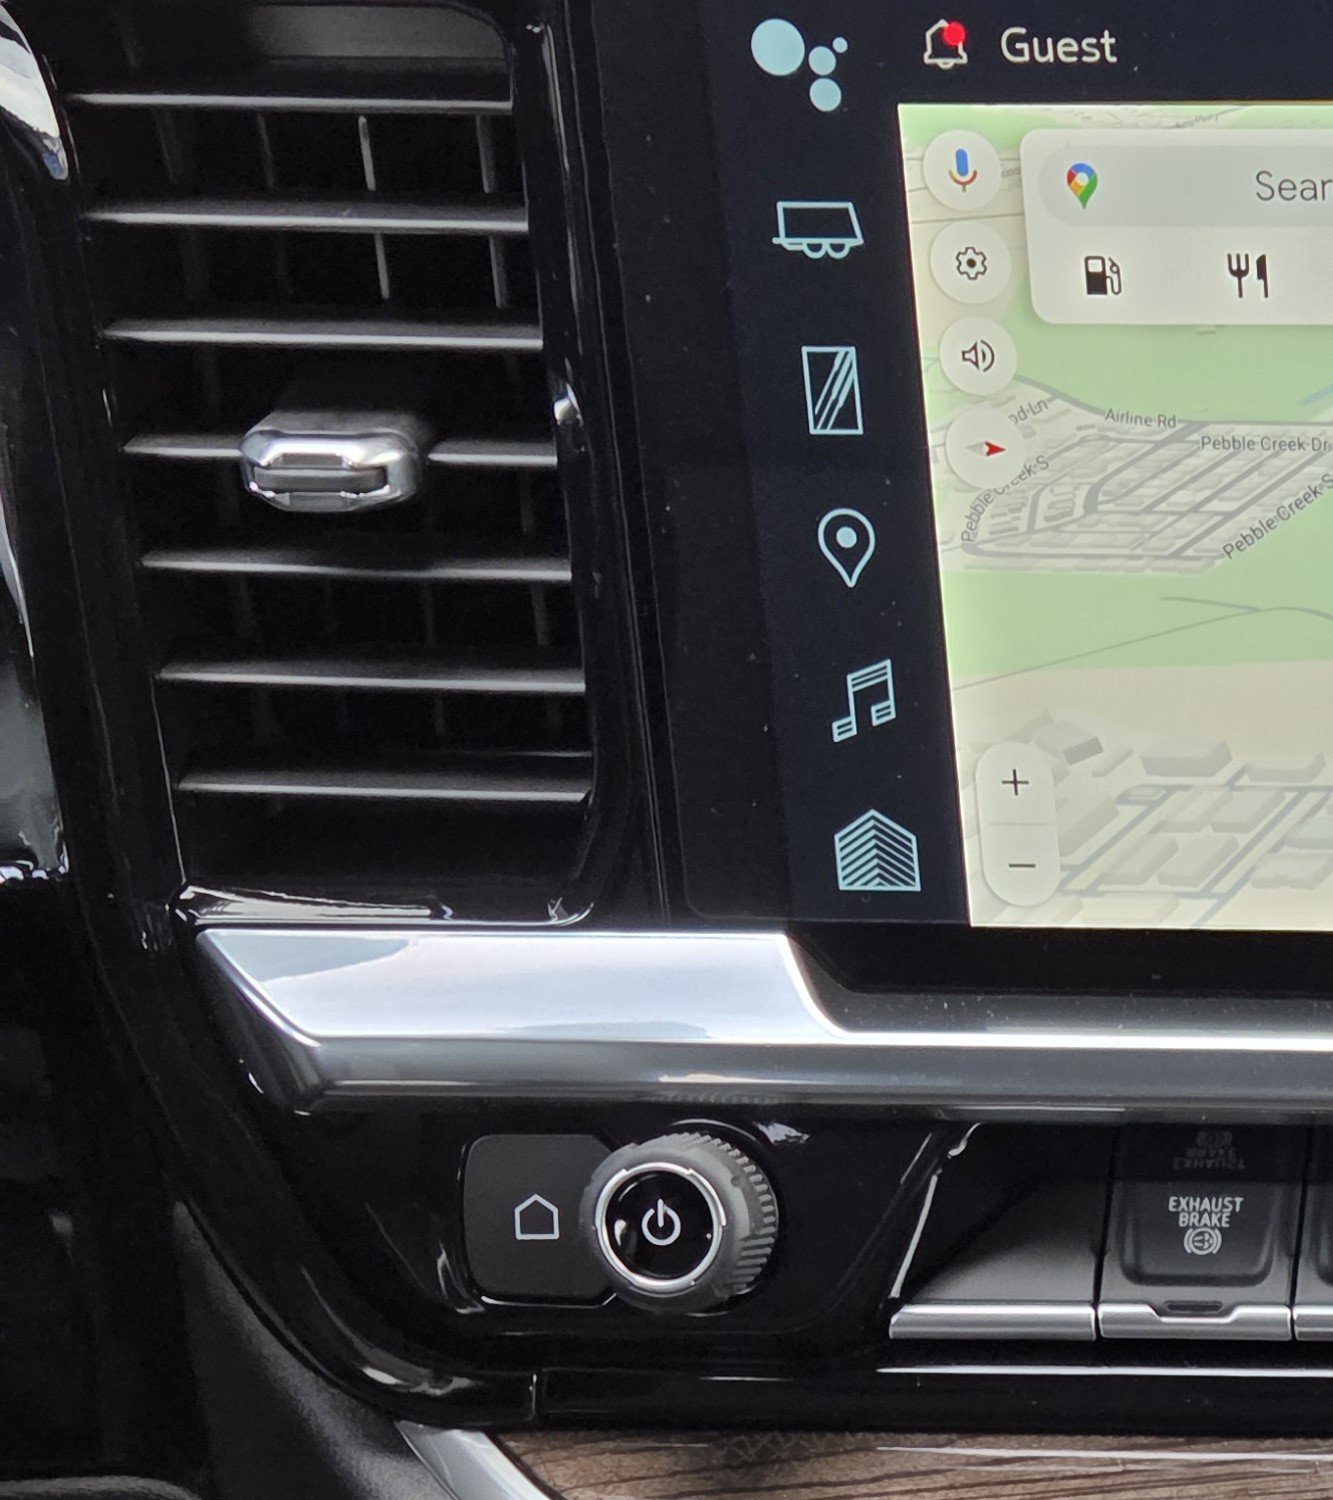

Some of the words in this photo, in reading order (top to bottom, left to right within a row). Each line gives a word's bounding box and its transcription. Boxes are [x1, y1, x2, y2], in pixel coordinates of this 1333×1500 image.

[1001, 27, 1118, 64] Guest
[1104, 407, 1155, 428] Airline
[1155, 412, 1177, 429] Rd
[1200, 435, 1257, 452] Pebble
[1259, 435, 1306, 452] Creek
[1311, 436, 1331, 452] Dr
[960, 490, 993, 545] Pebble
[1035, 455, 1050, 472] S
[1222, 516, 1278, 560] Pebble
[1274, 484, 1322, 523] Creek
[1168, 1196, 1244, 1213] EXHAUST
[1178, 1212, 1231, 1228] BRAKE
